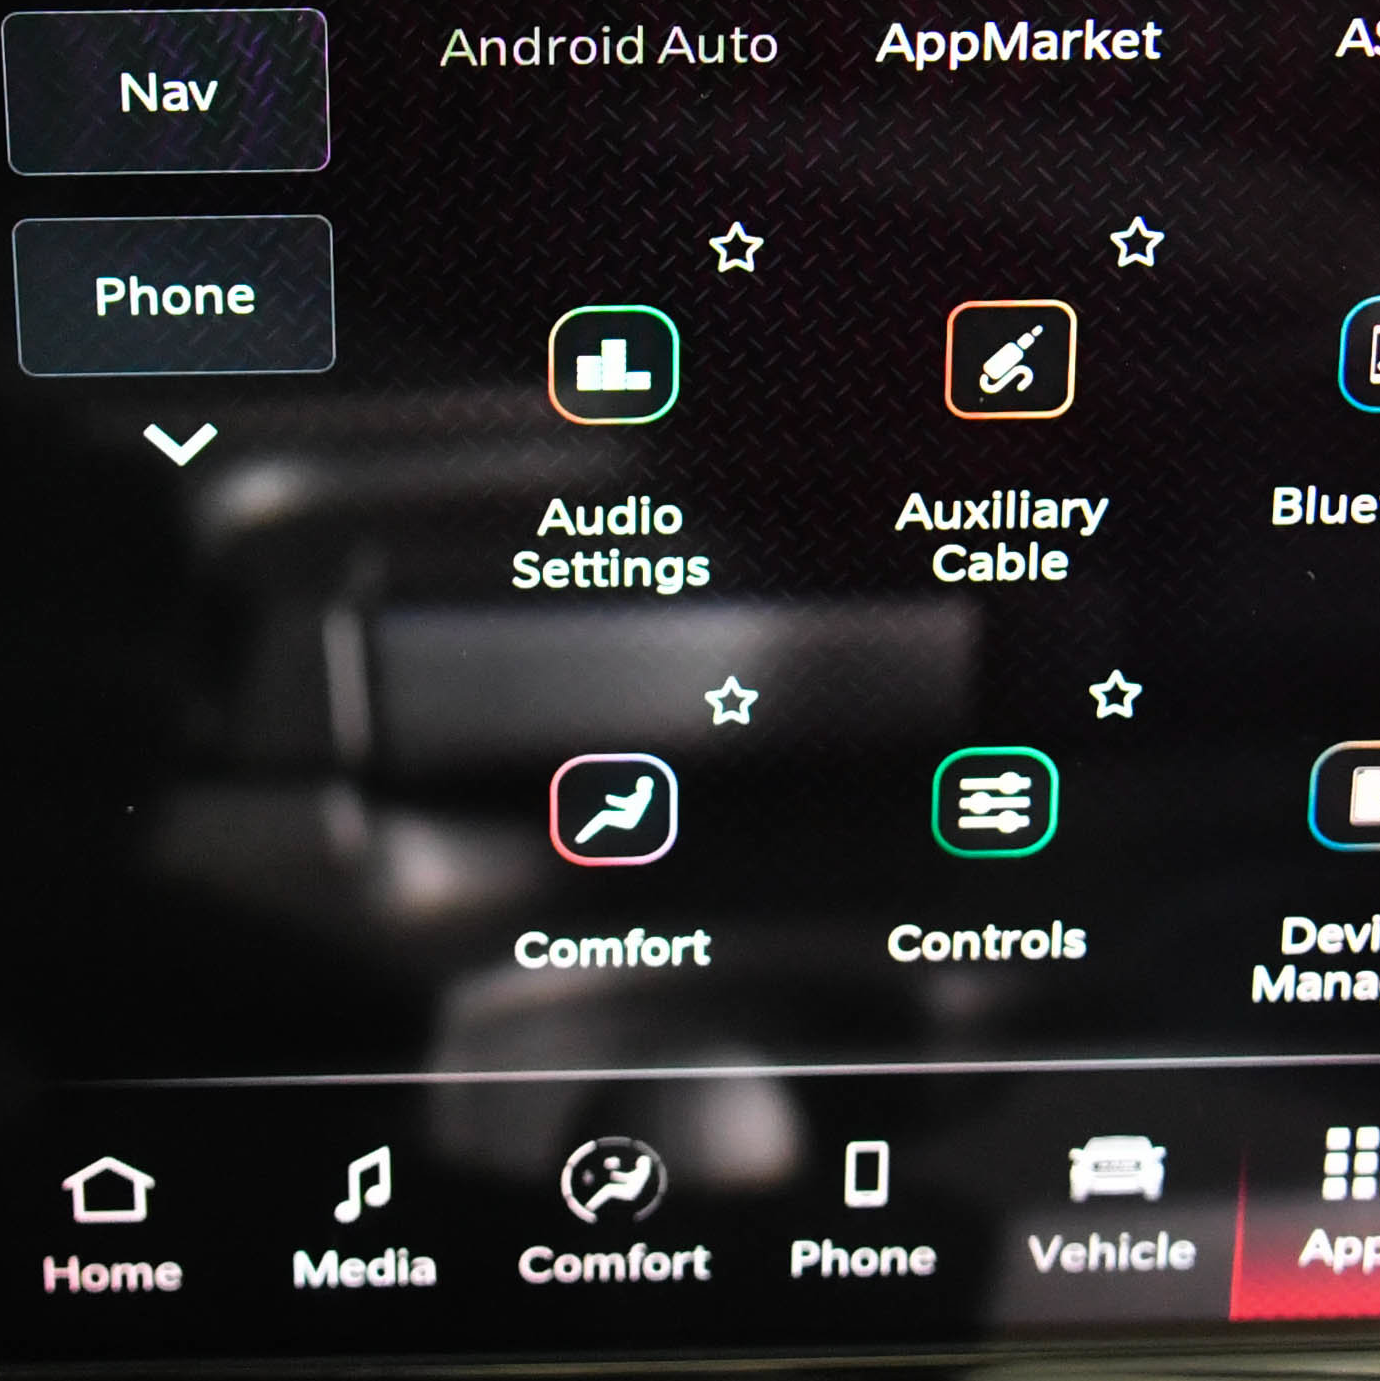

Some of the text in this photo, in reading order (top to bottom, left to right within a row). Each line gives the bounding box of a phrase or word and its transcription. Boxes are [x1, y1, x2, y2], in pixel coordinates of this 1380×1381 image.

[439, 23, 779, 68] Android Auto
[874, 18, 1164, 72] AppMarket
[119, 71, 219, 114] Nav
[94, 274, 256, 317] Phone
[535, 494, 684, 538] Audio
[893, 488, 1110, 538] Auxiliary
[510, 547, 711, 596] Settings
[931, 544, 1070, 583] Cable
[513, 926, 713, 972] Comfort
[886, 918, 1088, 964] Controls
[291, 1246, 438, 1289] Media
[517, 1241, 712, 1285] Comfort
[789, 1237, 938, 1279] Phone
[1027, 1229, 1198, 1273] Vehicle
[42, 1254, 184, 1293] Home
